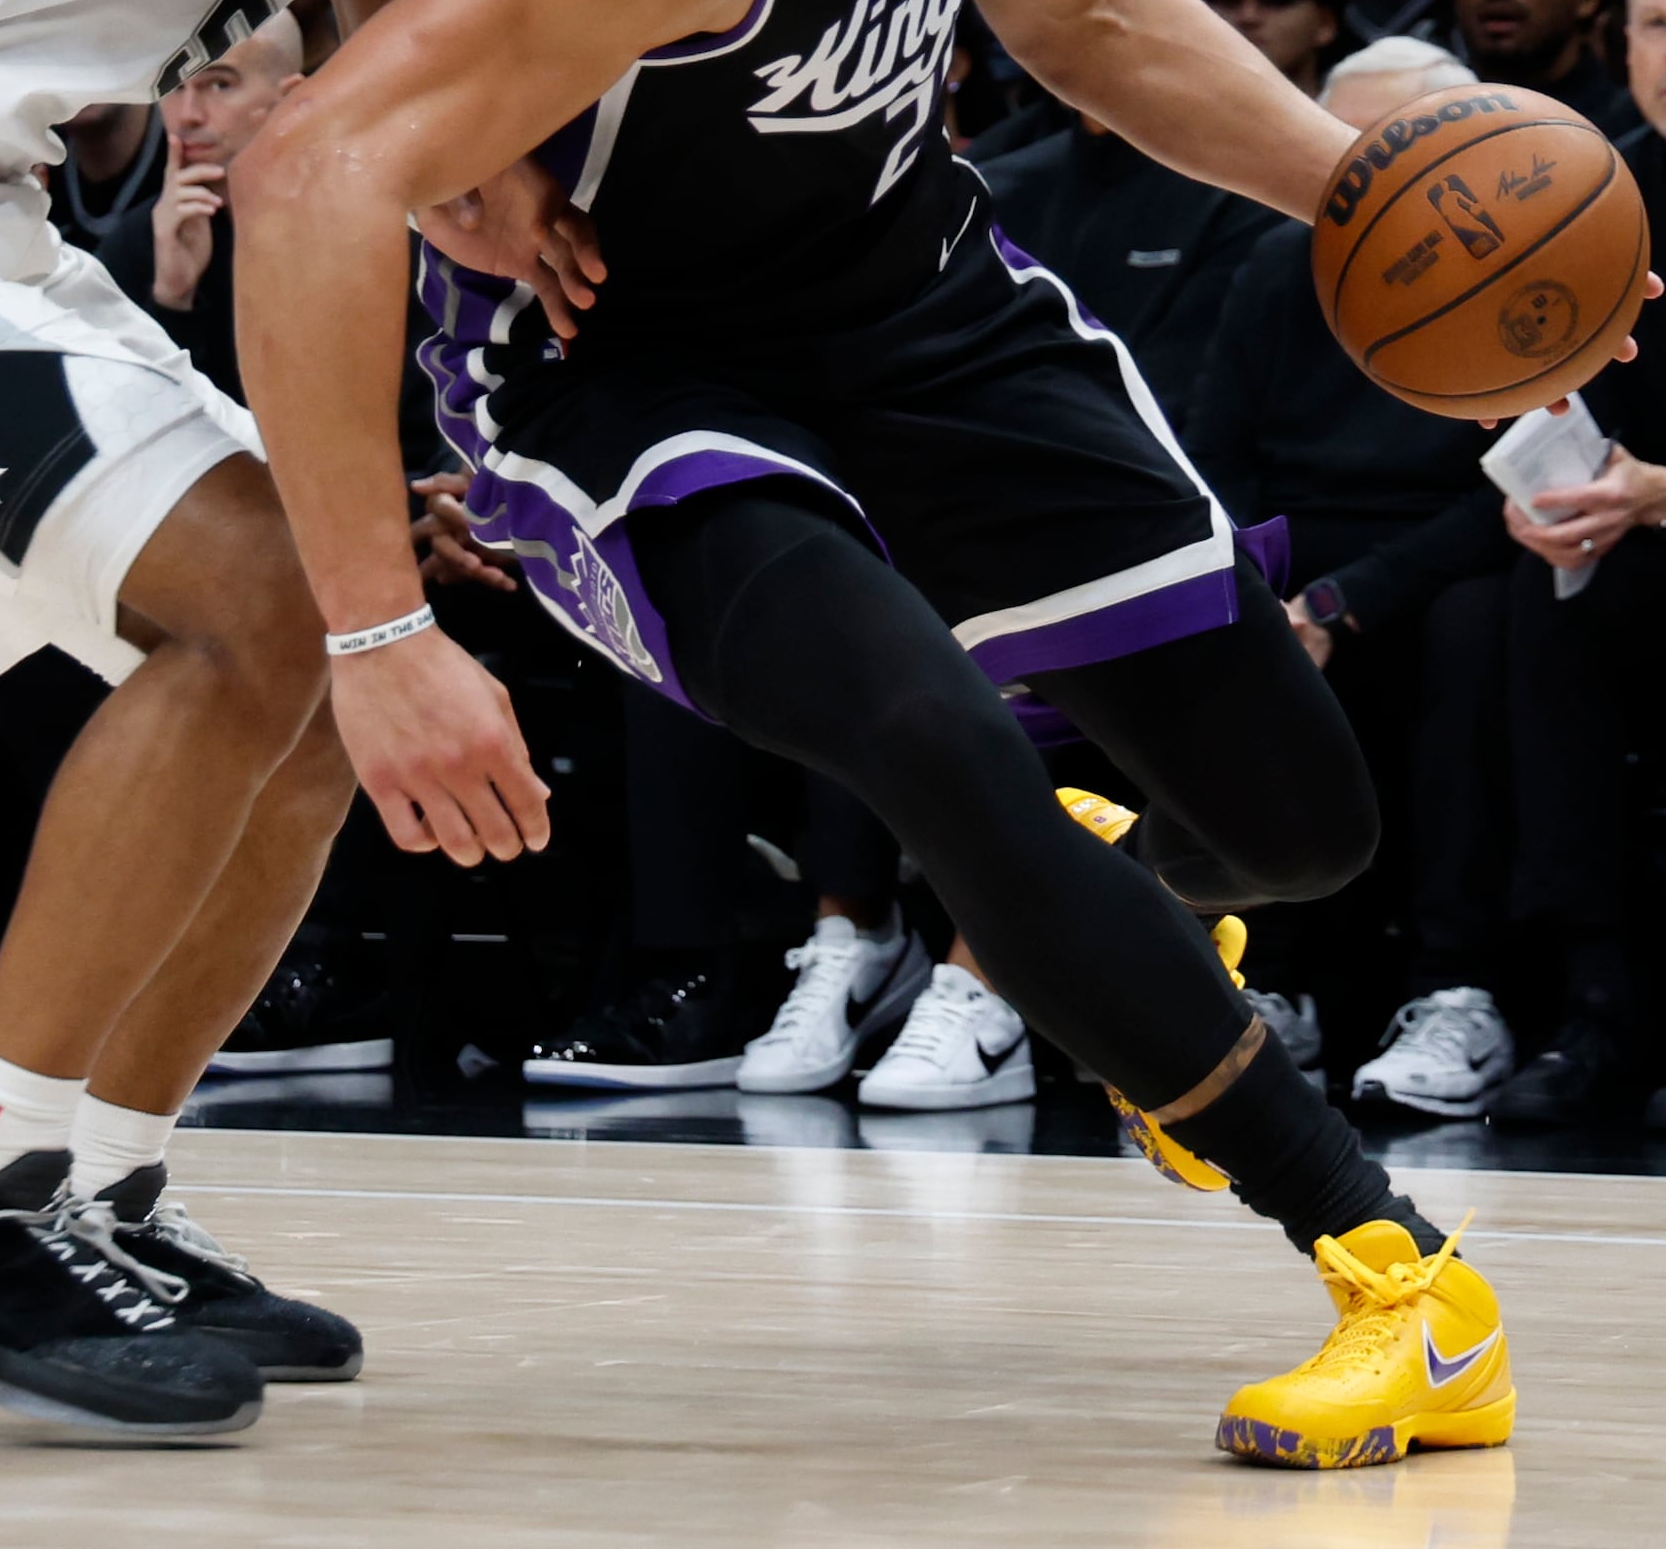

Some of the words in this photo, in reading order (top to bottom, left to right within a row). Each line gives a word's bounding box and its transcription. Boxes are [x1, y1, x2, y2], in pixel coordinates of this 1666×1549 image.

[1322, 92, 1521, 227] Wilson
[340, 637, 367, 650] WIN
[371, 630, 387, 643] IN
[390, 619, 414, 636] THE
